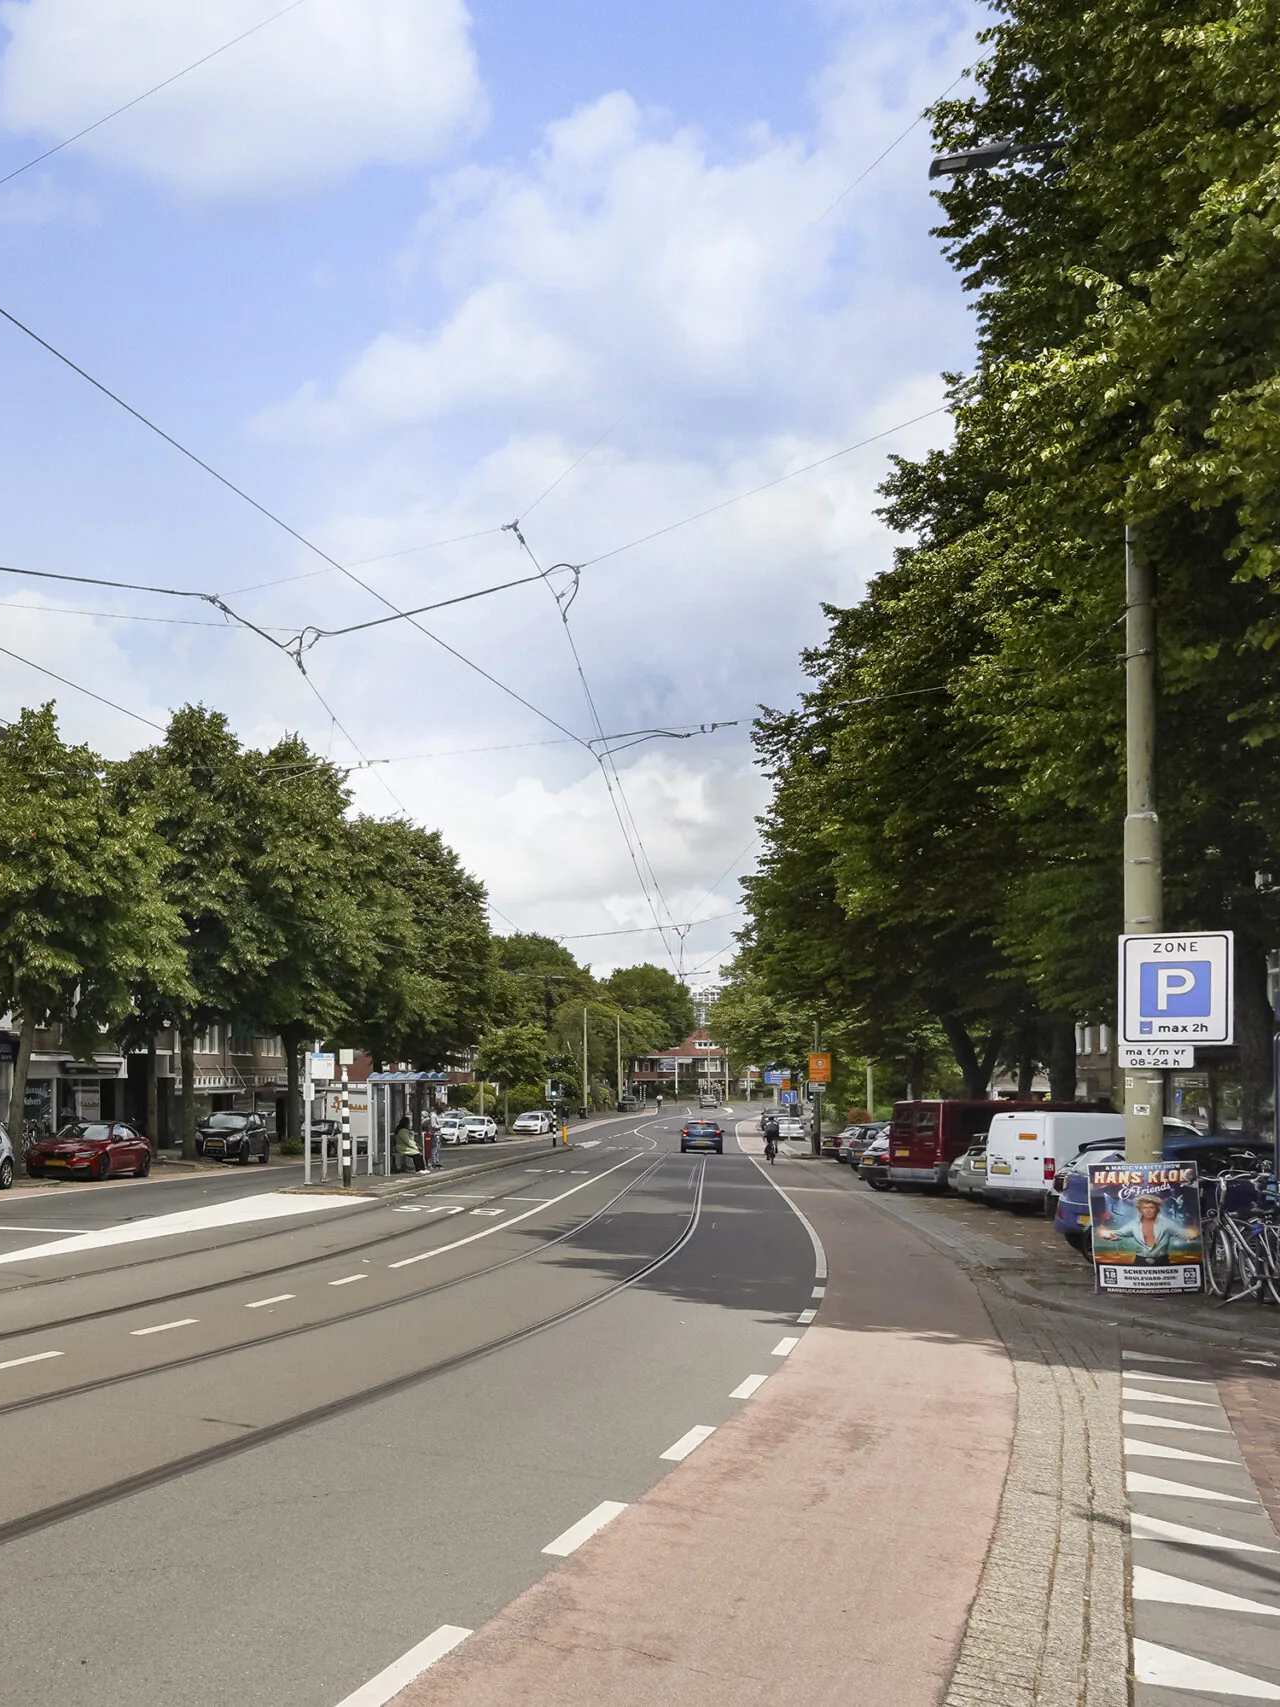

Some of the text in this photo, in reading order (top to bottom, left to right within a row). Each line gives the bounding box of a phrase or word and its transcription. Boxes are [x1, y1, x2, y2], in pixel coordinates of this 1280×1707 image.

[1153, 942, 1198, 953] ZONE
[1157, 968, 1195, 1010] P
[1158, 1023, 1208, 1032] max 2h
[1147, 1047, 1169, 1056] t/m
[1130, 1058, 1180, 1066] 08-24 h
[1093, 1168, 1193, 1185] HANS KLOK
[1131, 1180, 1171, 1195] Friends
